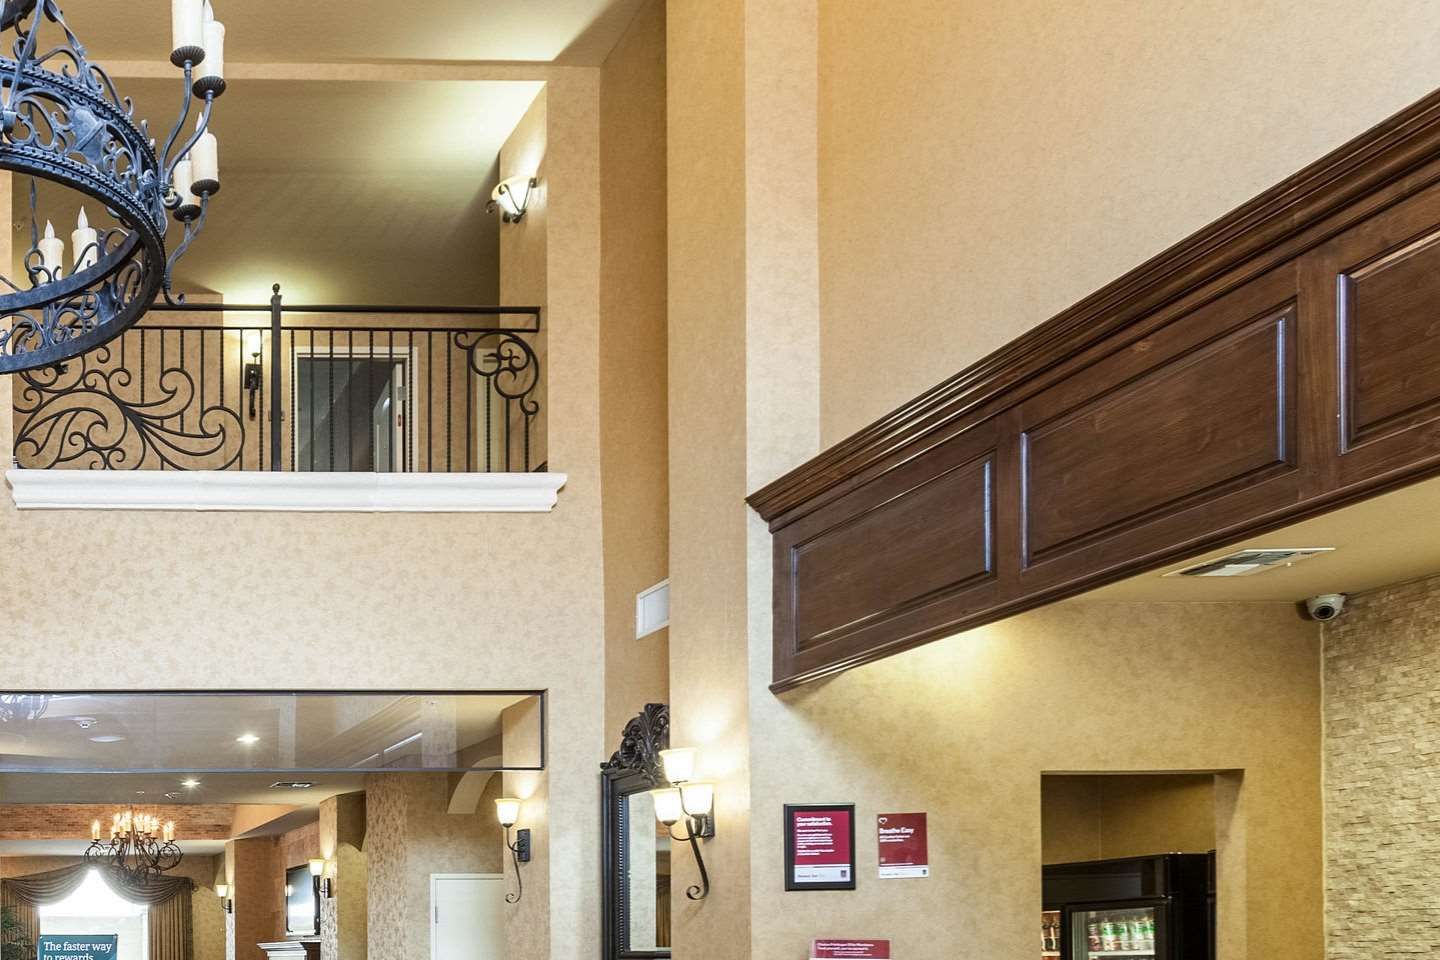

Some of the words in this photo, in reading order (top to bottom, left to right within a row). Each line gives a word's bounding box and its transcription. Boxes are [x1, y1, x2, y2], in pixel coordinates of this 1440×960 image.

[43, 941, 62, 951] The
[62, 941, 91, 951] faster
[91, 943, 112, 953] way
